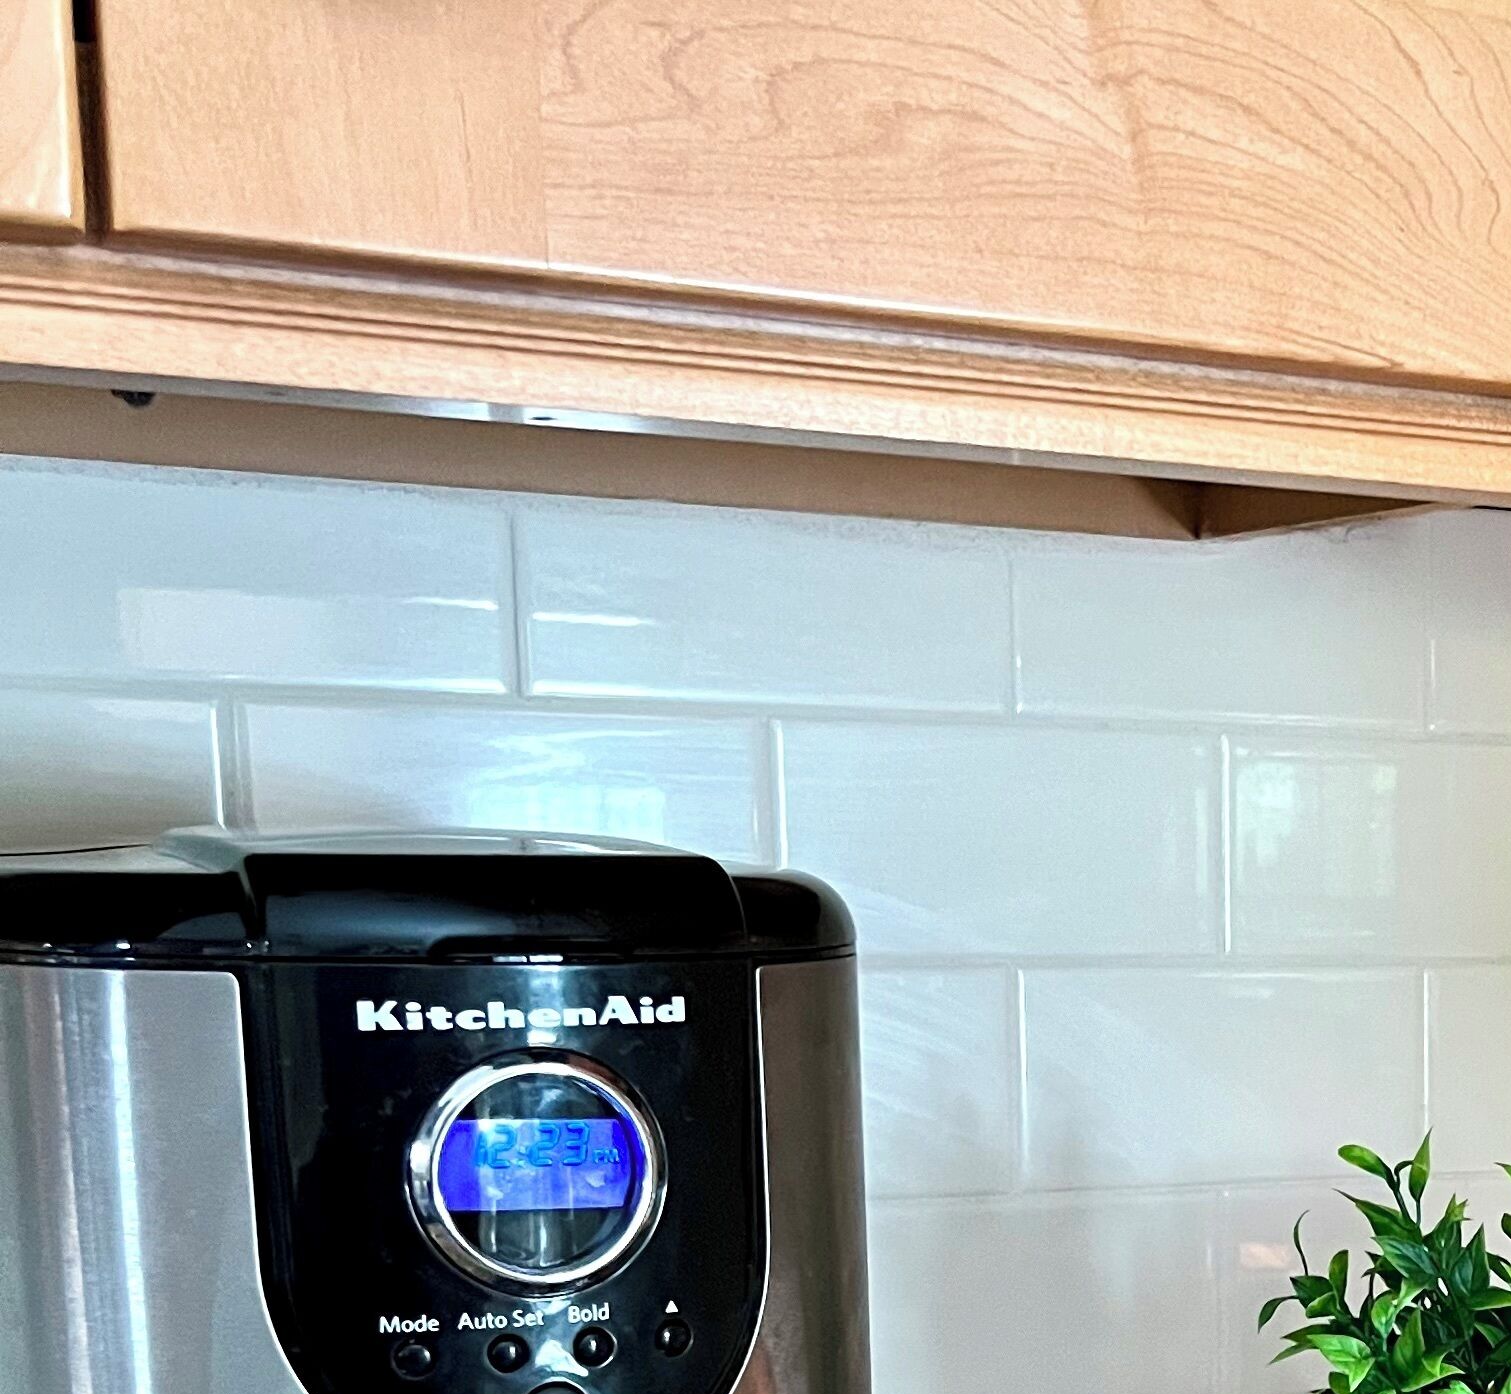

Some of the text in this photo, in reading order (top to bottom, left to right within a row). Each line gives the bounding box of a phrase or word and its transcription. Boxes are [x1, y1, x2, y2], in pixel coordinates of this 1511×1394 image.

[356, 996, 686, 1031] KitchenAid
[379, 1315, 440, 1333] Mode
[457, 1309, 544, 1330] Auto Set
[567, 1303, 610, 1324] Bold
